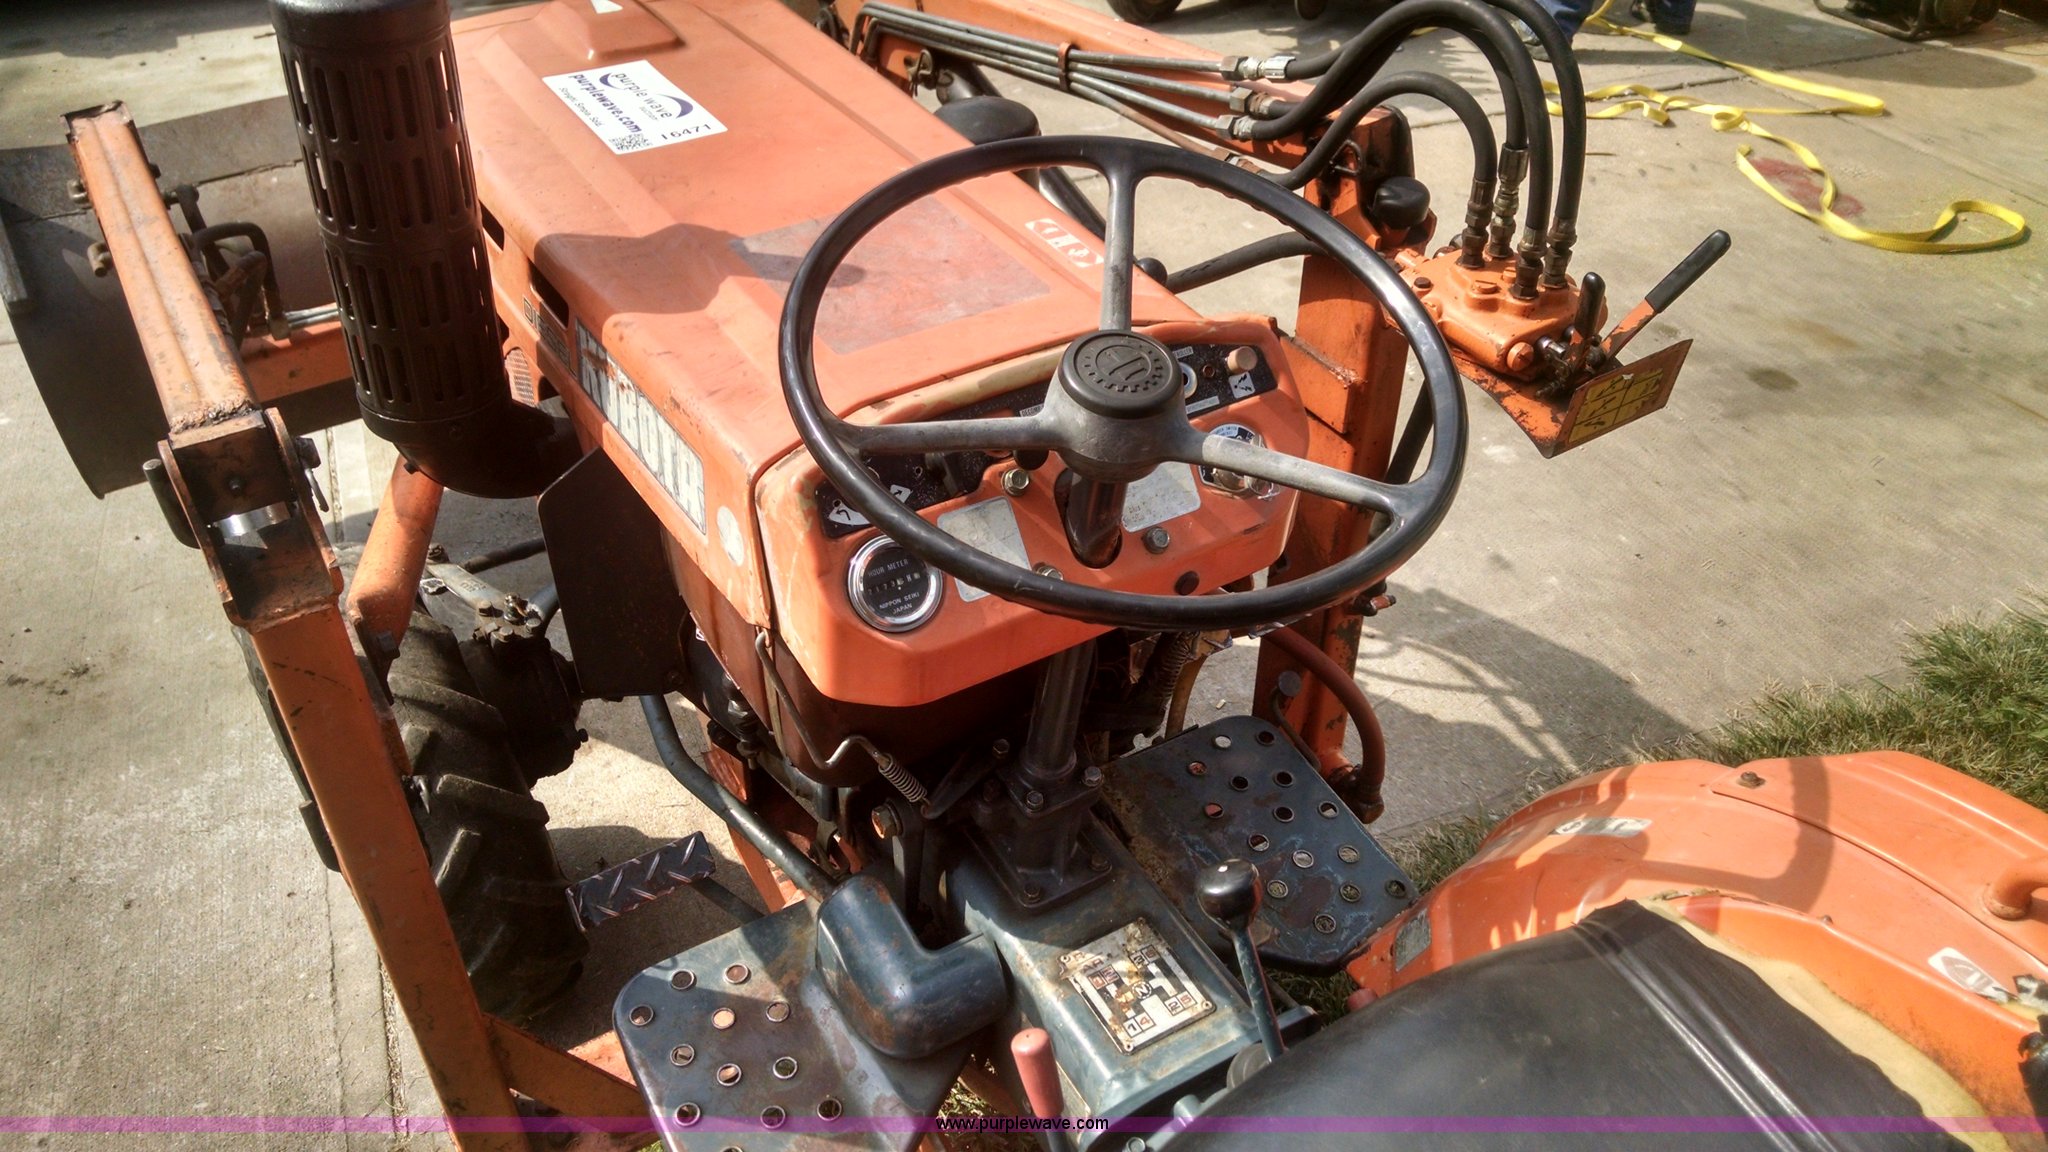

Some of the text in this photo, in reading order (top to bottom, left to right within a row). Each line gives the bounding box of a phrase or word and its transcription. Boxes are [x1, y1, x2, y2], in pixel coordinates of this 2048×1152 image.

[569, 73, 643, 134] purplewave.com
[611, 72, 673, 119] purple wave
[661, 123, 711, 140] 16471
[576, 319, 705, 534] KUBOTA
[868, 559, 909, 577] HOUR METER
[879, 591, 920, 609] NIPPON SEIKI
[893, 602, 913, 614] JAPAN
[1168, 1001, 1180, 1012] 2
[1140, 1016, 1150, 1026] 4
